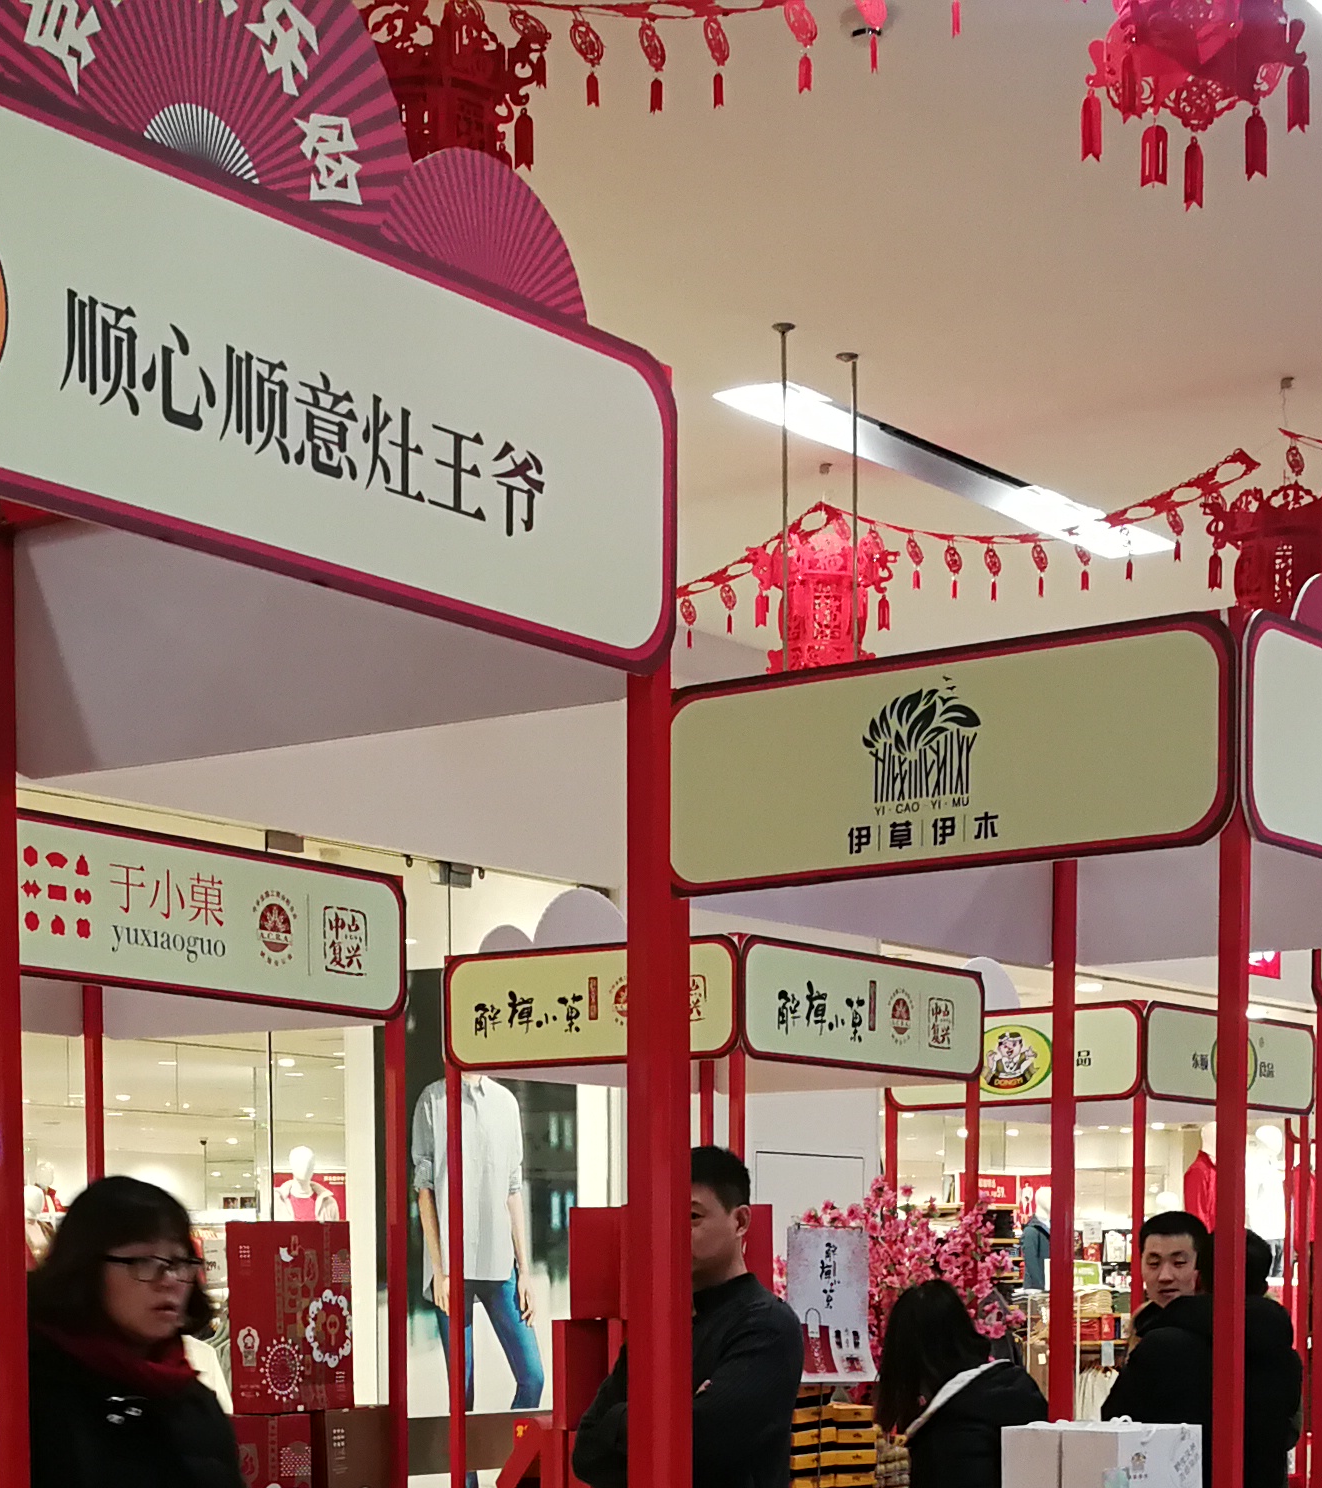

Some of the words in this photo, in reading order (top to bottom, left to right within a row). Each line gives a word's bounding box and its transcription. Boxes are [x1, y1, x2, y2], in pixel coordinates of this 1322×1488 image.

[60, 287, 547, 538] 顺心顺意灶王爷
[847, 811, 1000, 856] 伊草伊木
[109, 862, 225, 928] 于小菓
[111, 923, 227, 964] yuxiaoguo
